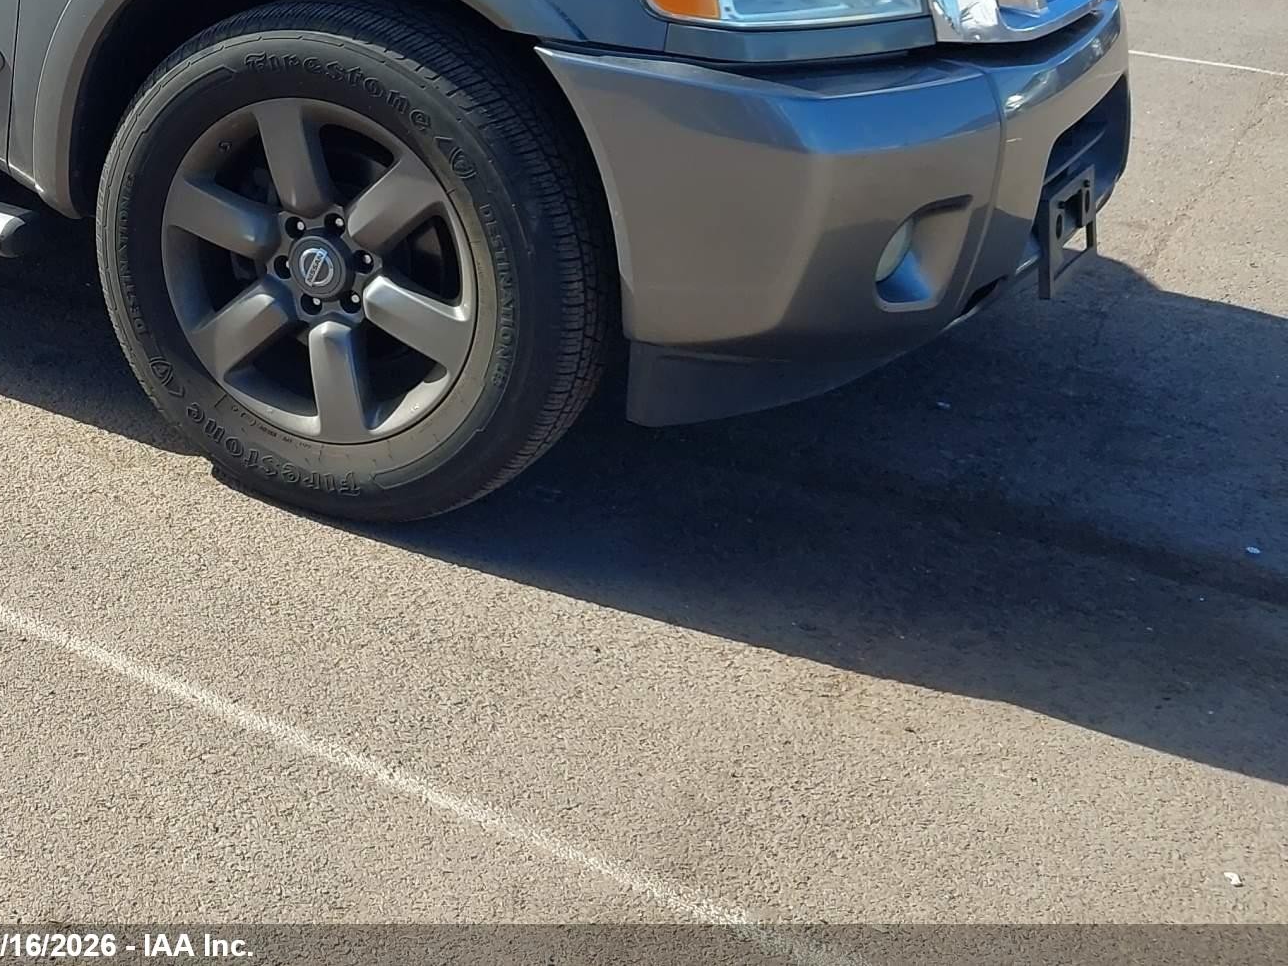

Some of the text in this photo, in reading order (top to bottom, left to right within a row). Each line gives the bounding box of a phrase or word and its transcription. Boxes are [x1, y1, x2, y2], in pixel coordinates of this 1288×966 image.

[243, 51, 432, 131] Firestone
[478, 202, 514, 363] DESTINATION
[186, 401, 361, 497] Firestone
